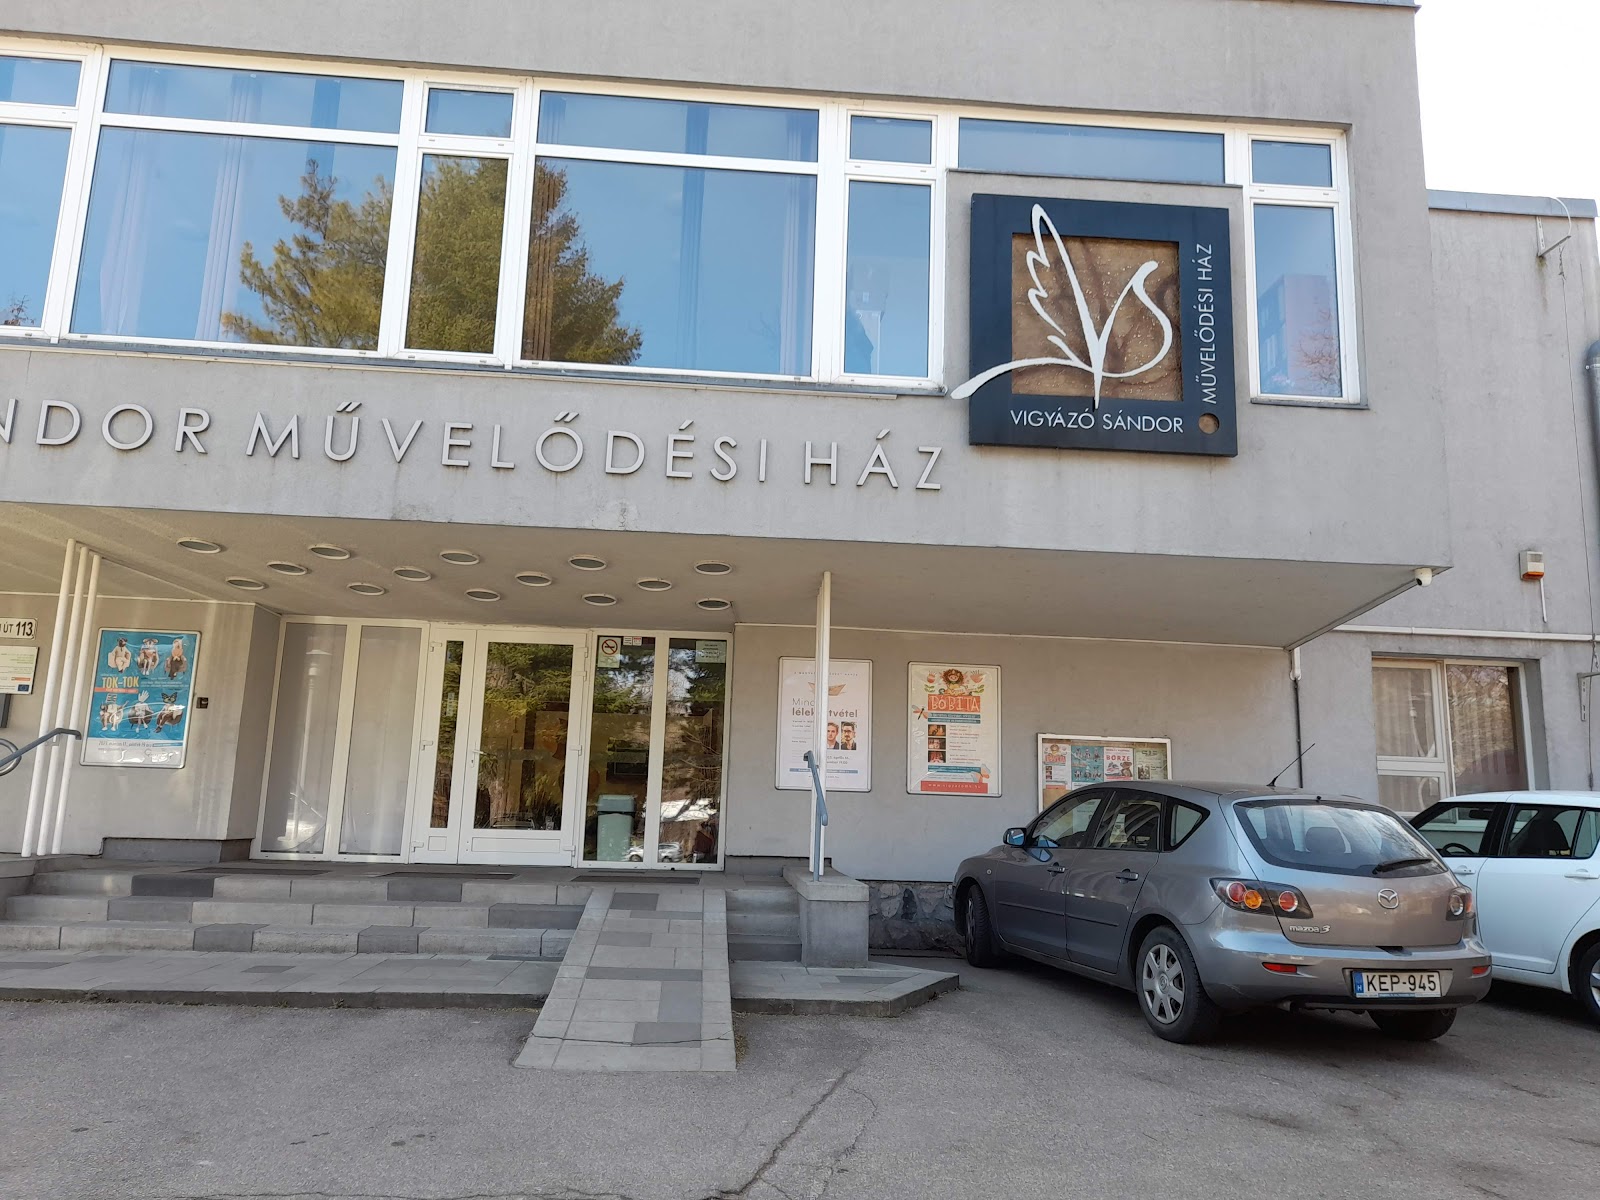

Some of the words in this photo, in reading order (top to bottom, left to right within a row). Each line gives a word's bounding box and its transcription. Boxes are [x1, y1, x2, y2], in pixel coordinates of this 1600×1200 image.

[1191, 243, 1213, 282] HÁZ
[1193, 288, 1217, 405] MŰVELŐDÉSI
[1010, 406, 1095, 430] VIGYÁZÓ
[1102, 410, 1184, 433] SÁNDOR
[246, 401, 767, 483] MŰVELŐDÉSI
[804, 428, 943, 491] HÁZ
[102, 676, 140, 689] TOK-TOK
[1289, 925, 1320, 933] mazda
[1320, 925, 1331, 934] 3
[1366, 974, 1437, 992] KEP-945
